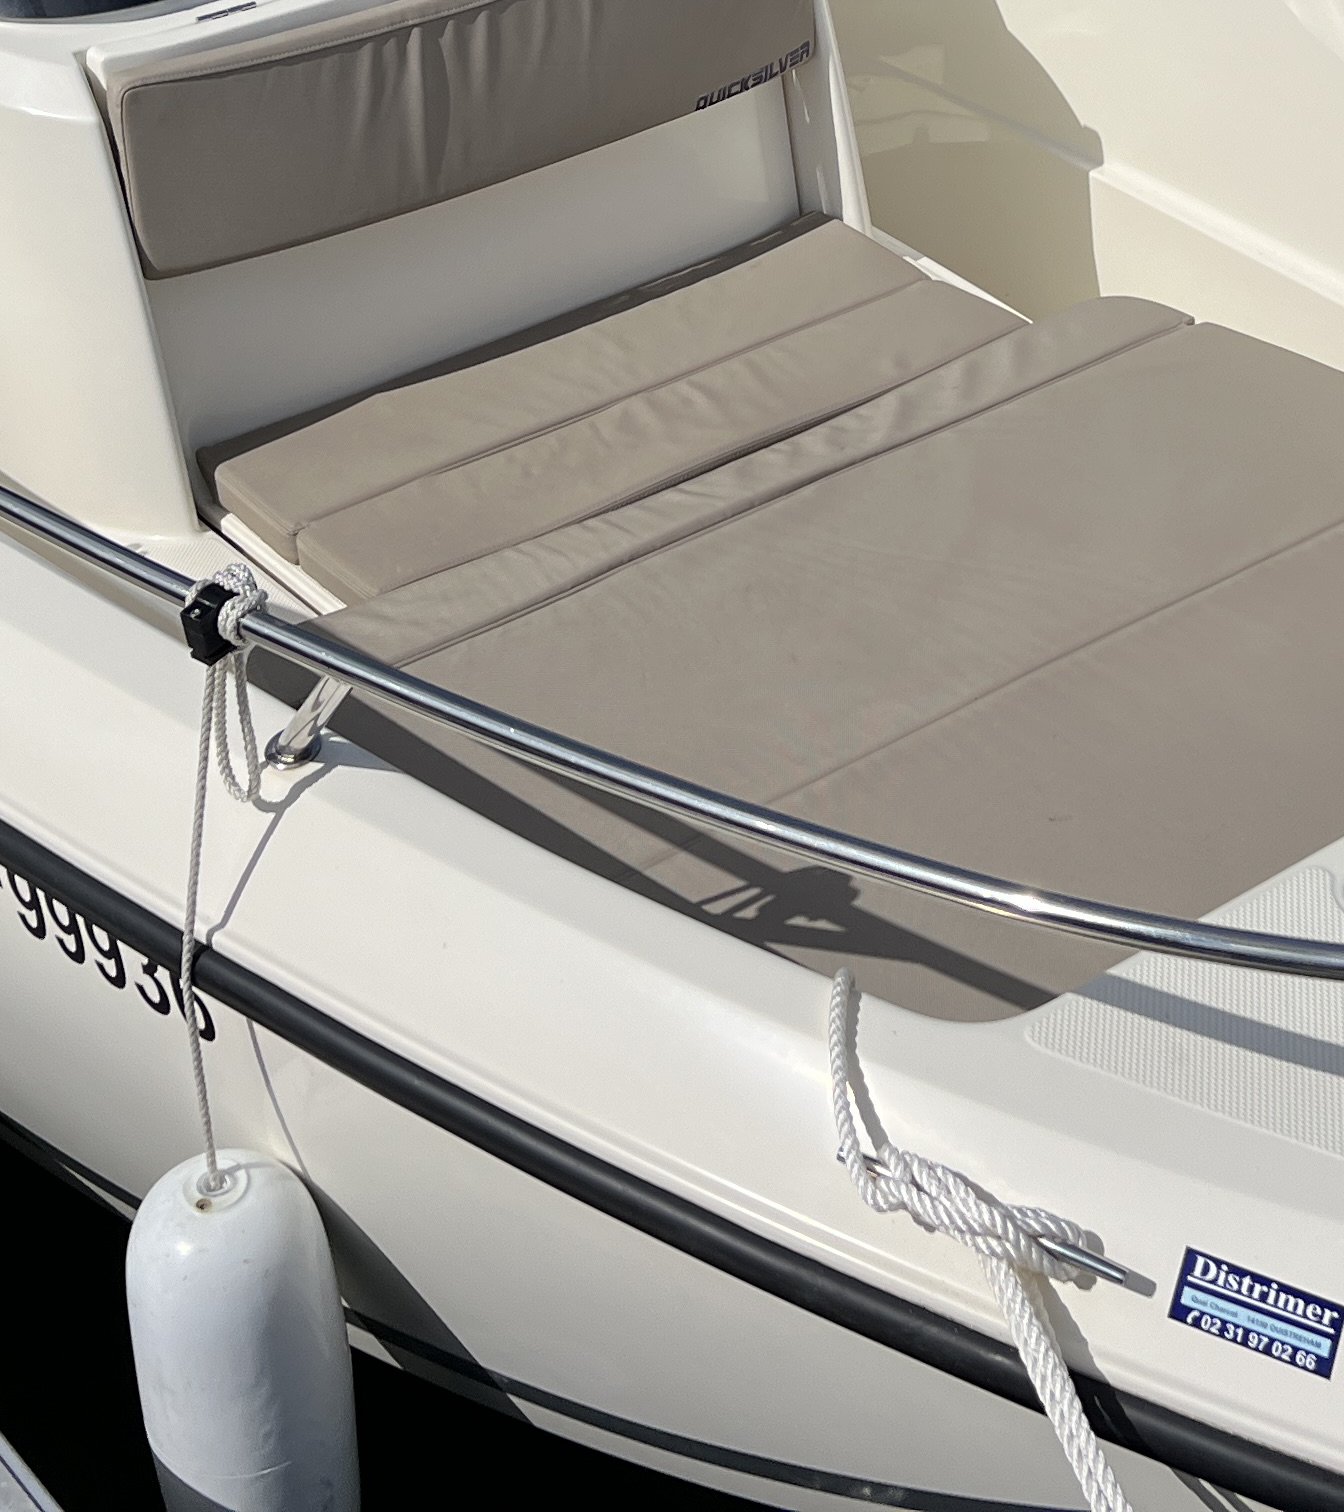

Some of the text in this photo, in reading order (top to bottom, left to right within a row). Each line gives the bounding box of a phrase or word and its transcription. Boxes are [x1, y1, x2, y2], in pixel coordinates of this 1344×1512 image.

[694, 40, 810, 111] QUICKSILVER
[1192, 1254, 1340, 1327] Distrimer
[1200, 1314, 1317, 1370] 02 31 97 02 66
